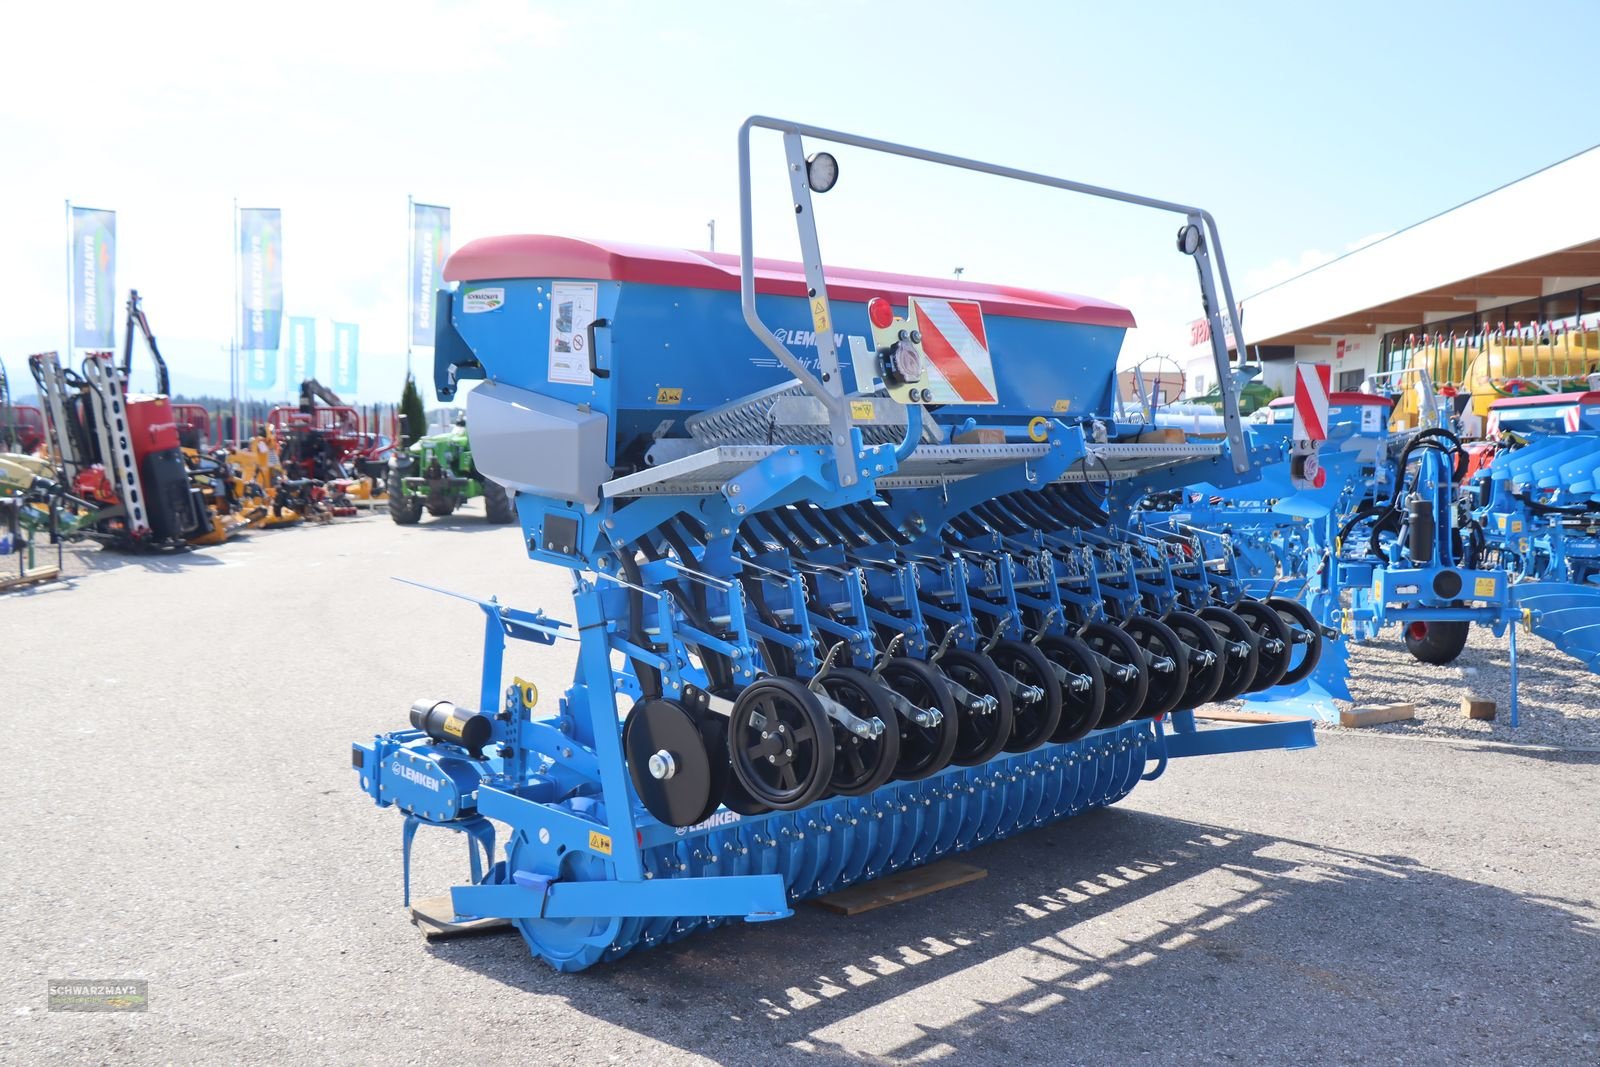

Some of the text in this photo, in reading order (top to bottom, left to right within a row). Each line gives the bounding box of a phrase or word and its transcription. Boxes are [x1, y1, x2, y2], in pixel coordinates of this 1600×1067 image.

[83, 234, 97, 331] SCHWARZMAYR
[419, 231, 433, 328] SCHWARZMAYR
[786, 330, 844, 348] LEMN
[401, 765, 440, 792] LEMKEN
